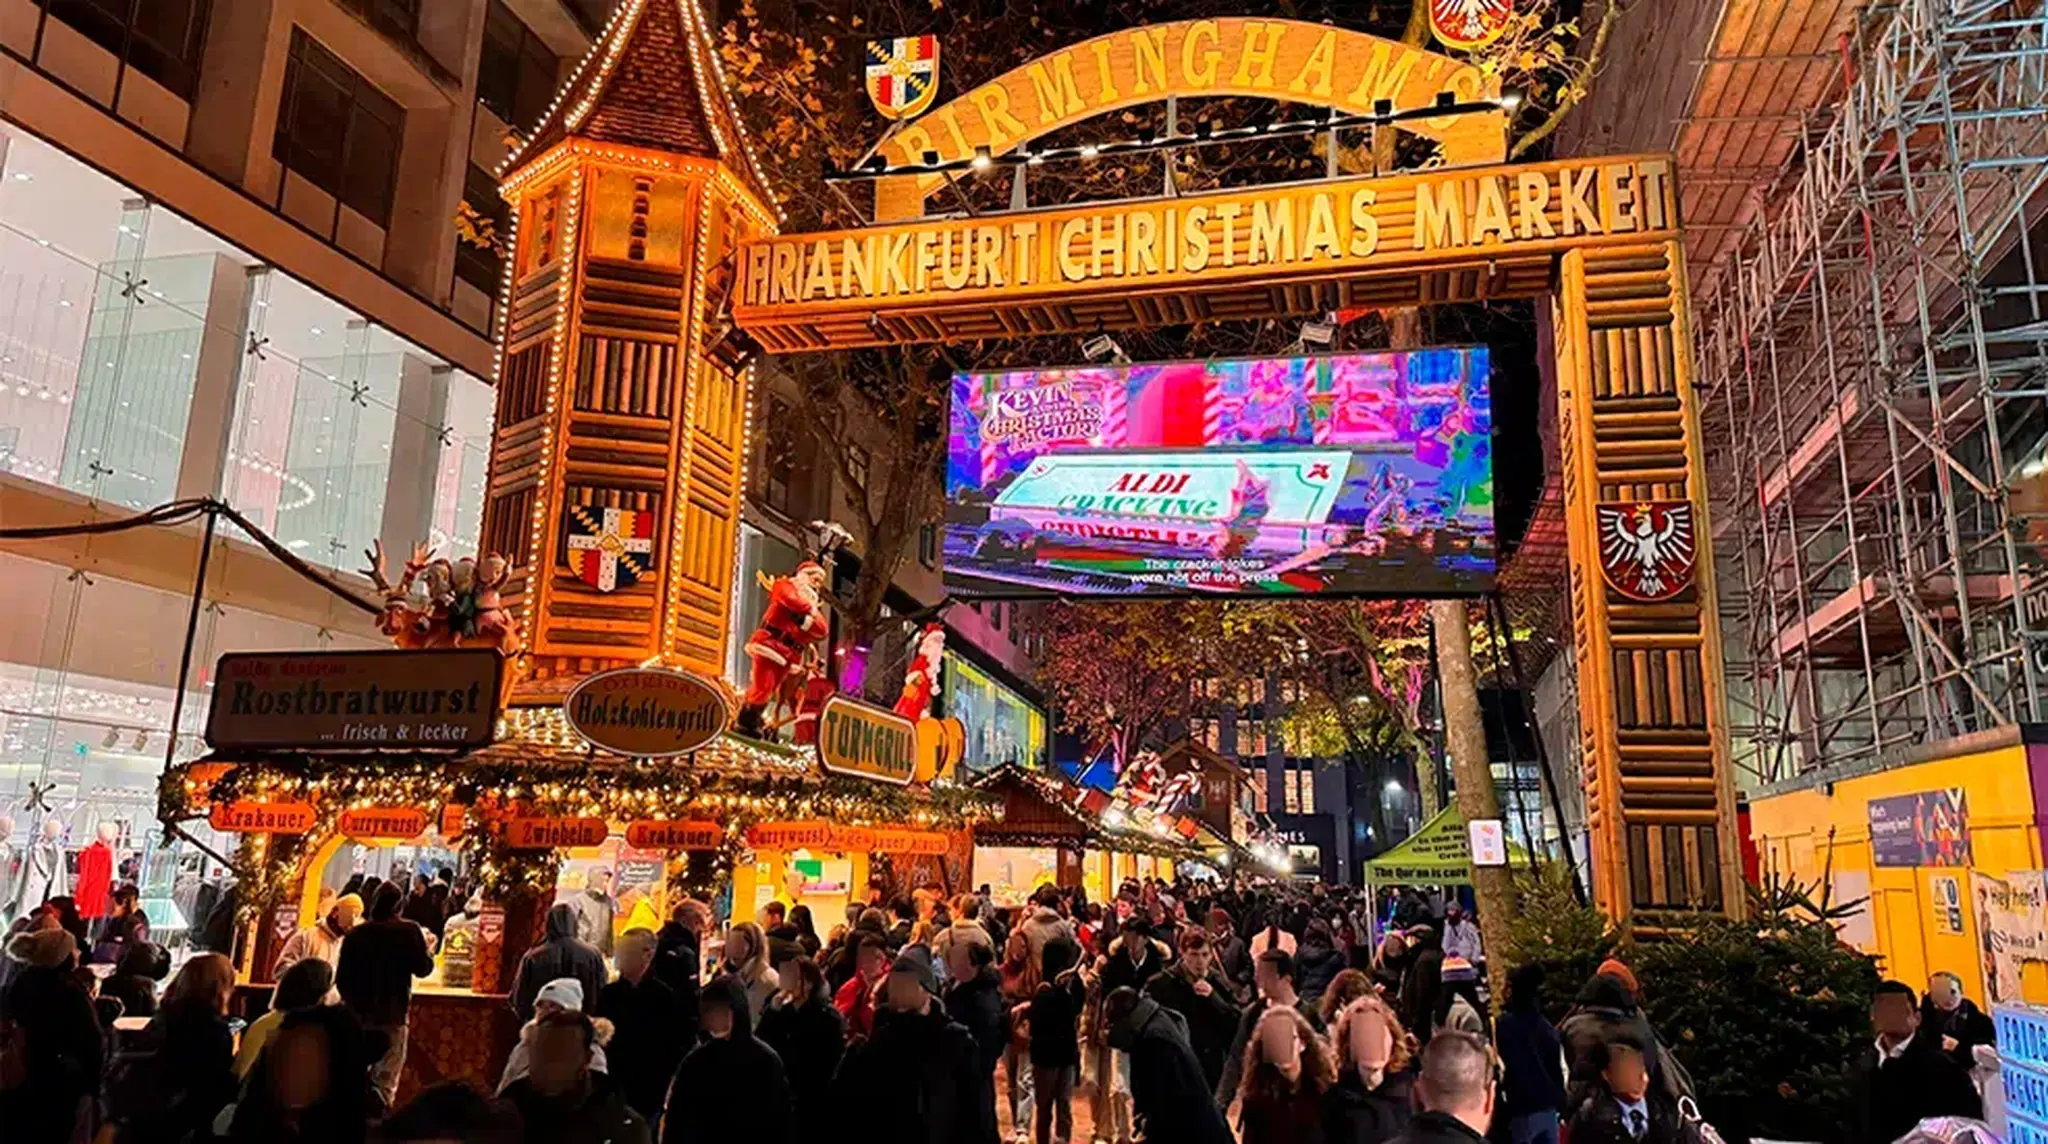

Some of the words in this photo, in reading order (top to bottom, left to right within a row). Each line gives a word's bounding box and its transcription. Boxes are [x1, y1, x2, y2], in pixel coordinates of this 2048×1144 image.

[895, 20, 1483, 189] BIRMINGHAM'S
[746, 222, 1037, 304] FRANKFURT
[1059, 189, 1379, 281] CHRISTMAS
[1413, 160, 1668, 249] MARKET
[988, 382, 1072, 418] KEVIN
[1108, 473, 1191, 494] ALDI
[1144, 558, 1169, 570] The
[1173, 558, 1223, 570] cracker
[1227, 558, 1265, 571] jokes
[1192, 572, 1211, 583] off
[1213, 571, 1236, 583] the
[230, 678, 481, 716] Rostbratwurst
[577, 693, 718, 740] Holzkohlengrill
[342, 723, 388, 741] frisch
[396, 724, 409, 741] &
[419, 723, 468, 741] lecker
[220, 807, 306, 829] Krakauer
[341, 813, 420, 837] Currywurst
[522, 820, 594, 845] Zwiebeln
[635, 823, 713, 846] Krakauer
[749, 827, 824, 848] Currywurst
[1374, 866, 1393, 878] The
[1431, 866, 1442, 878] is
